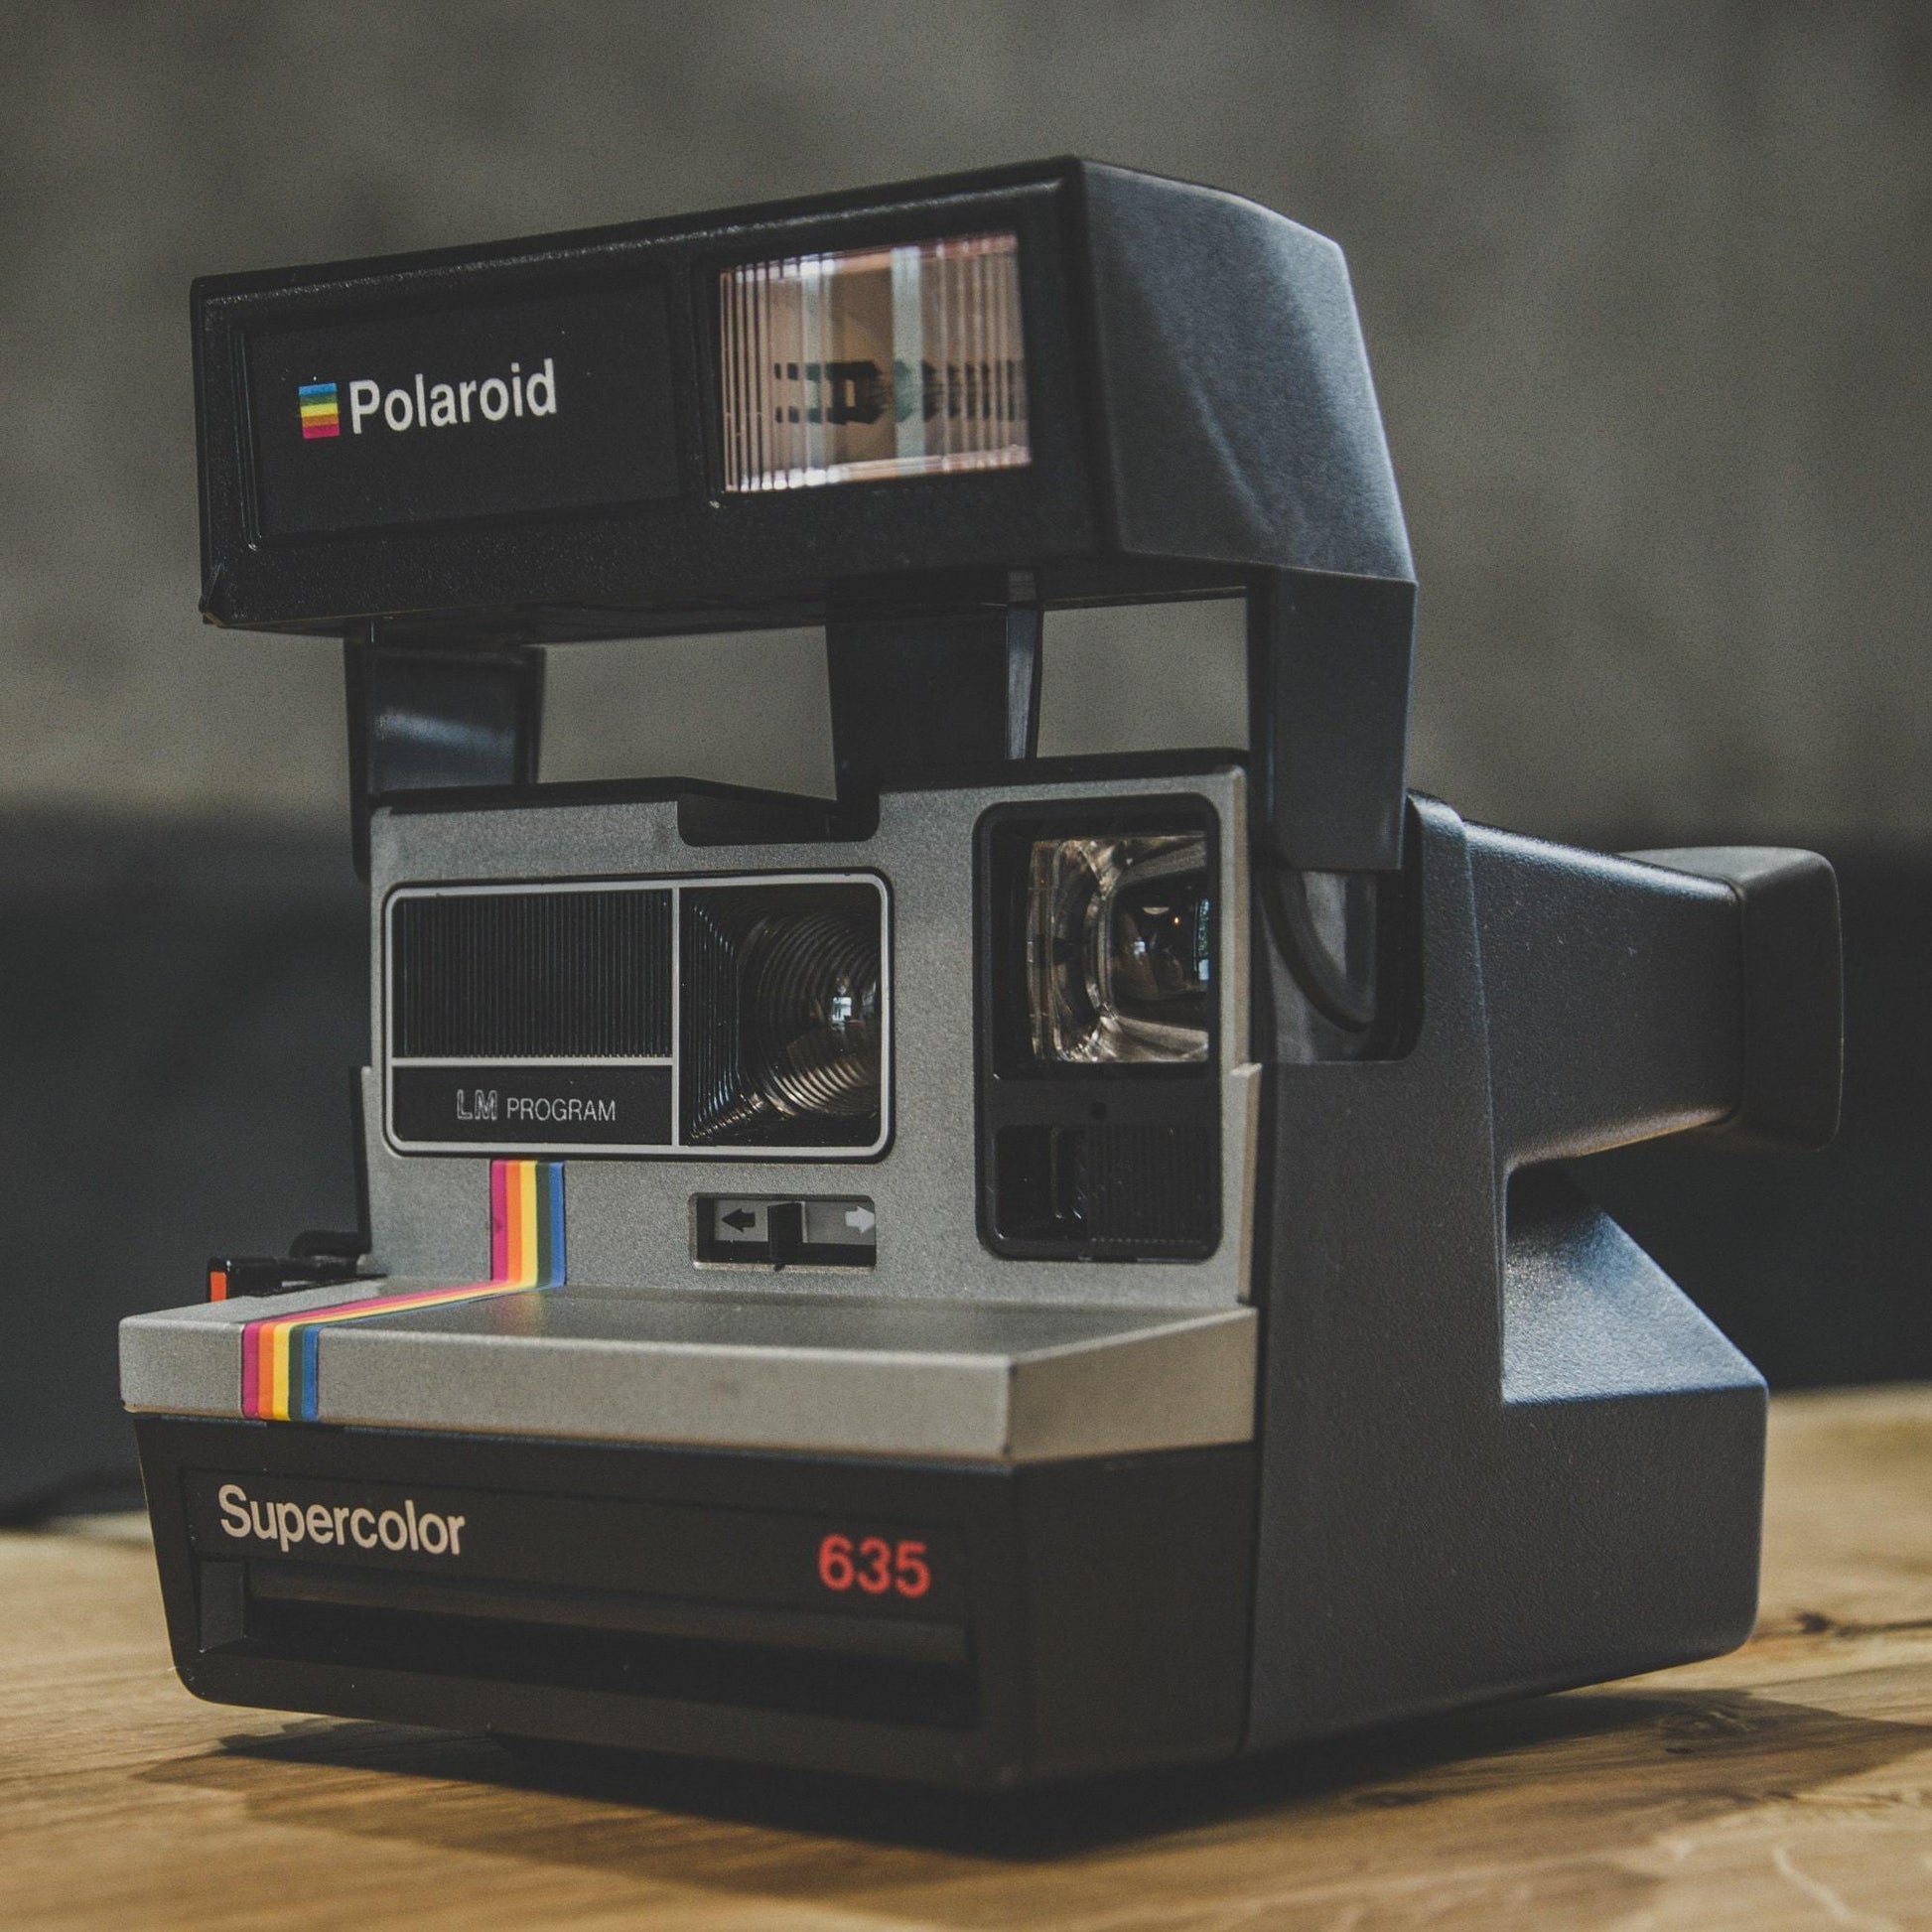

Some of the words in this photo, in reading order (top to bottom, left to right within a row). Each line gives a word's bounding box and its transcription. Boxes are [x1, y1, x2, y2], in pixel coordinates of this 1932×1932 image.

[349, 357, 557, 434] Polaroid
[456, 1089, 497, 1121] LM
[506, 1097, 616, 1121] PROGRAM
[218, 1484, 465, 1555] Supercolor
[819, 1534, 931, 1597] 635
